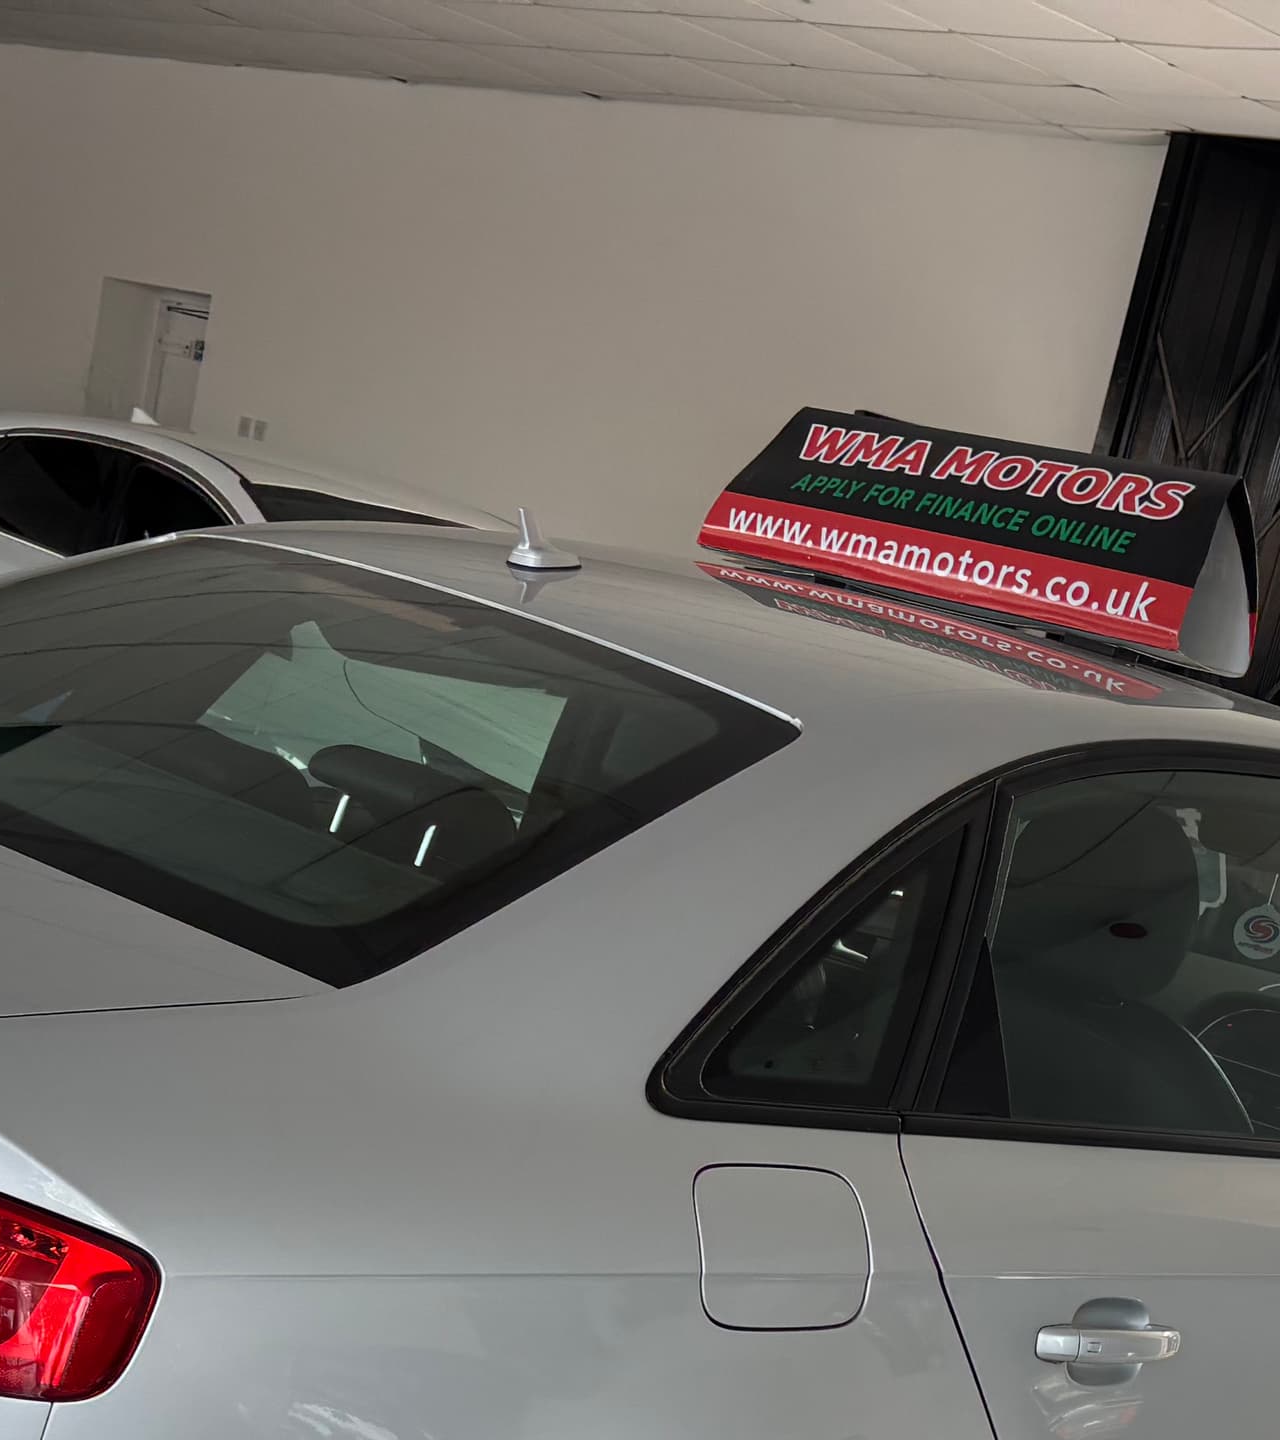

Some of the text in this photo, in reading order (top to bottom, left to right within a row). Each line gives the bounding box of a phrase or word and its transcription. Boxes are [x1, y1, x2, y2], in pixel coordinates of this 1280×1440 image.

[790, 473, 1137, 554] APPLY FOR FINANCE ONLINE
[799, 424, 1196, 521] WMA MOTORS
[727, 507, 1158, 623] www.wmamotors.co.uk
